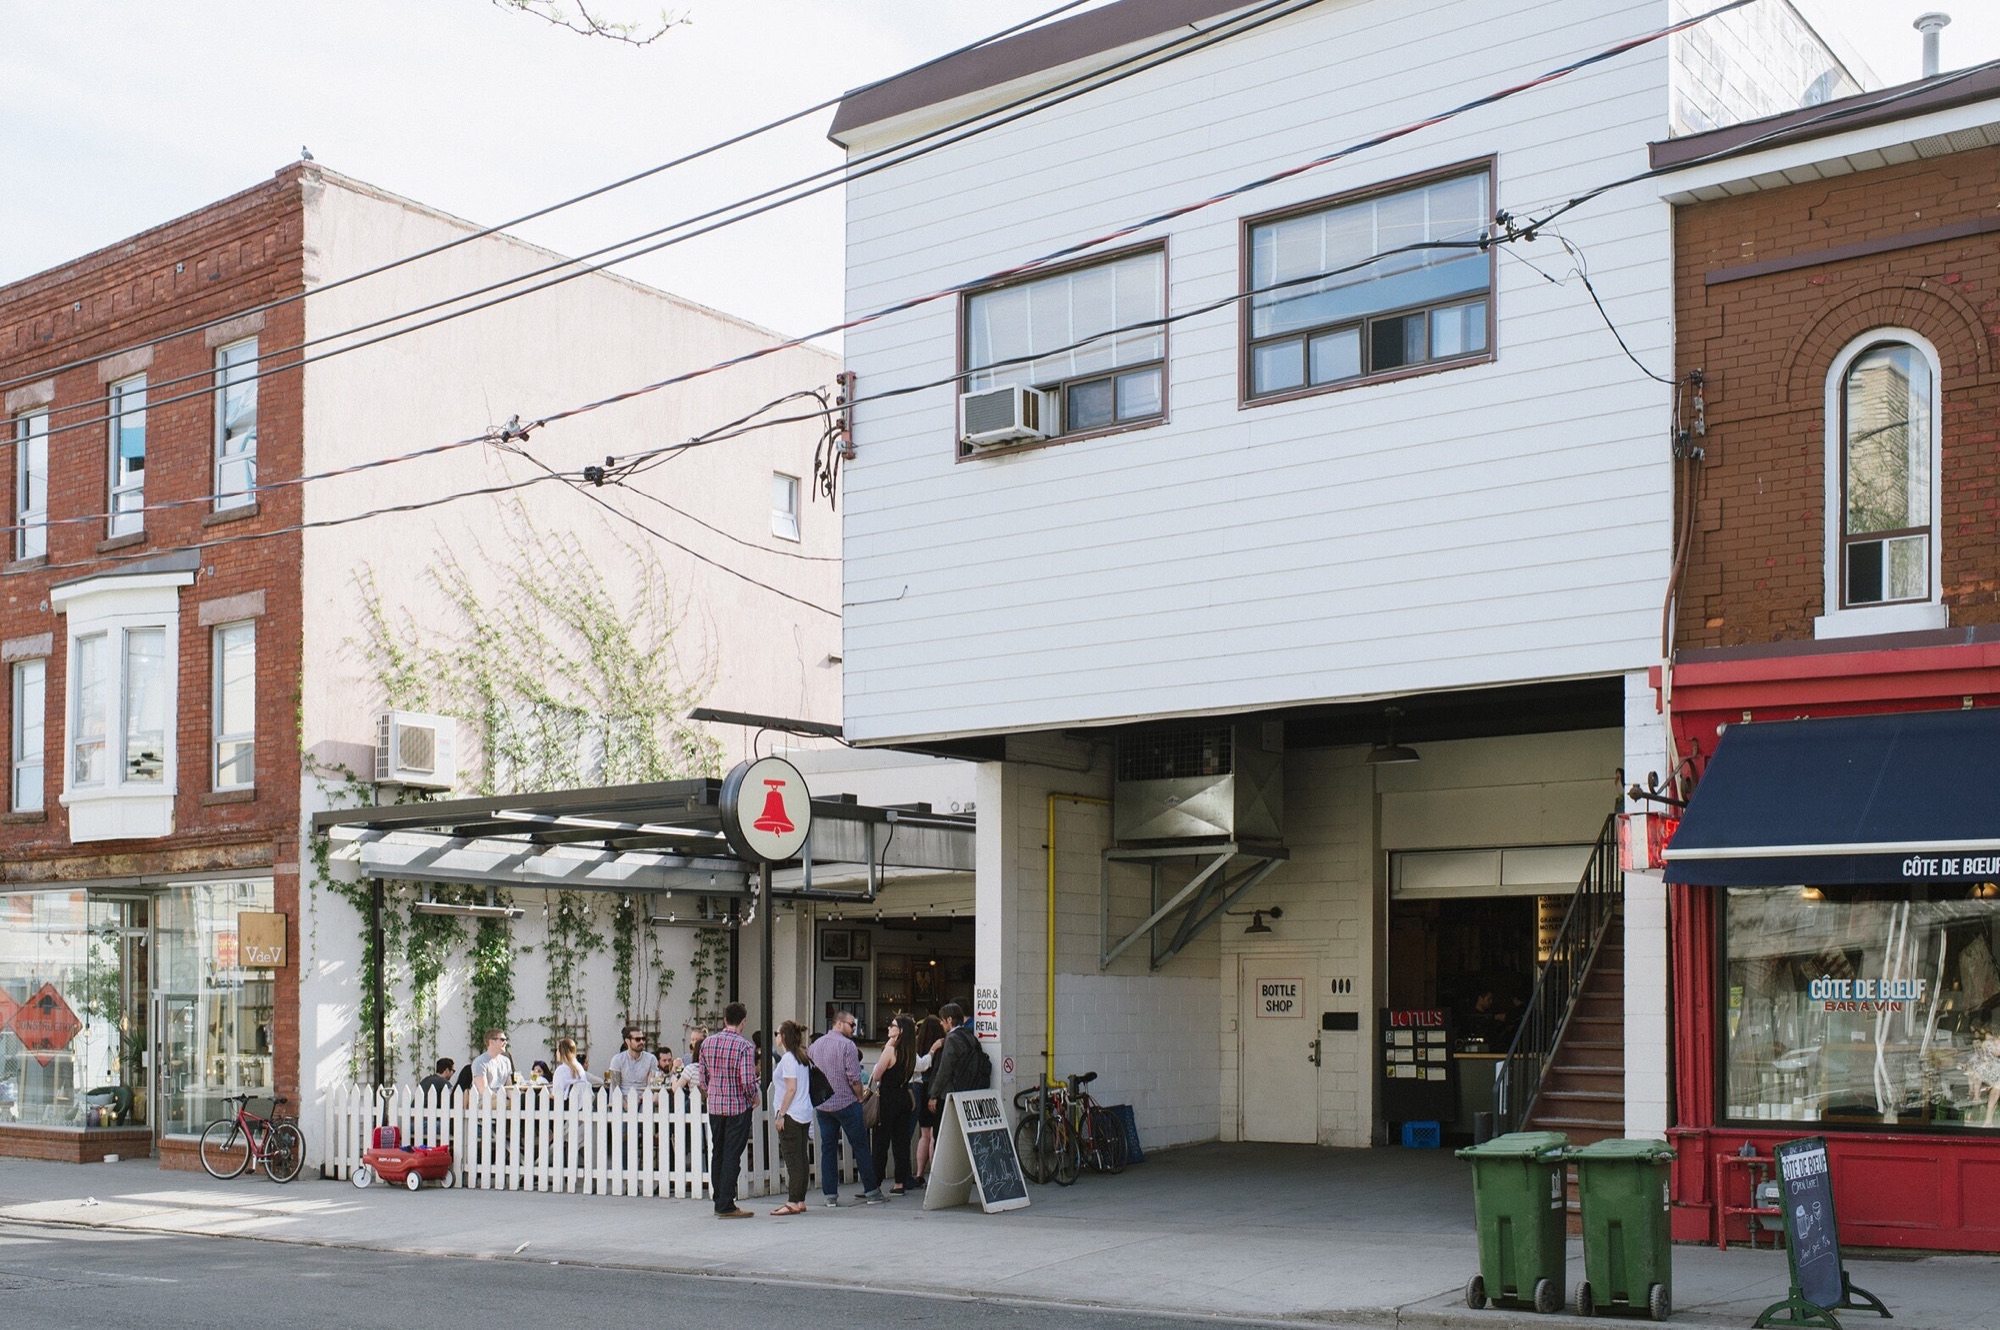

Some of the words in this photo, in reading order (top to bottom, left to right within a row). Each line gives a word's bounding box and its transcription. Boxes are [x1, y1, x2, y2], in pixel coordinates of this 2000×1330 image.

[1902, 855, 1939, 877] CÔTE
[1941, 858, 1961, 876] DE
[245, 946, 282, 963] VdeV
[1262, 984, 1296, 997] BOTTLE
[1809, 974, 1852, 1000] CÔTE
[1853, 979, 1876, 1000] DE
[1878, 979, 1927, 1000] BŒUF
[976, 989, 992, 999] BAR
[992, 989, 999, 999] &
[977, 1000, 998, 1010] FOOD
[1266, 999, 1293, 1012] SHOP
[1824, 1001, 1855, 1012] BAR
[1873, 1001, 1903, 1013] VIN
[18, 1018, 76, 1034] ONSTRUCTION
[975, 1021, 999, 1031] RETAIL
[962, 1097, 1001, 1121] BELLWOODS
[967, 1118, 1003, 1128] BREWERY
[1798, 1157, 1809, 1177] DE
